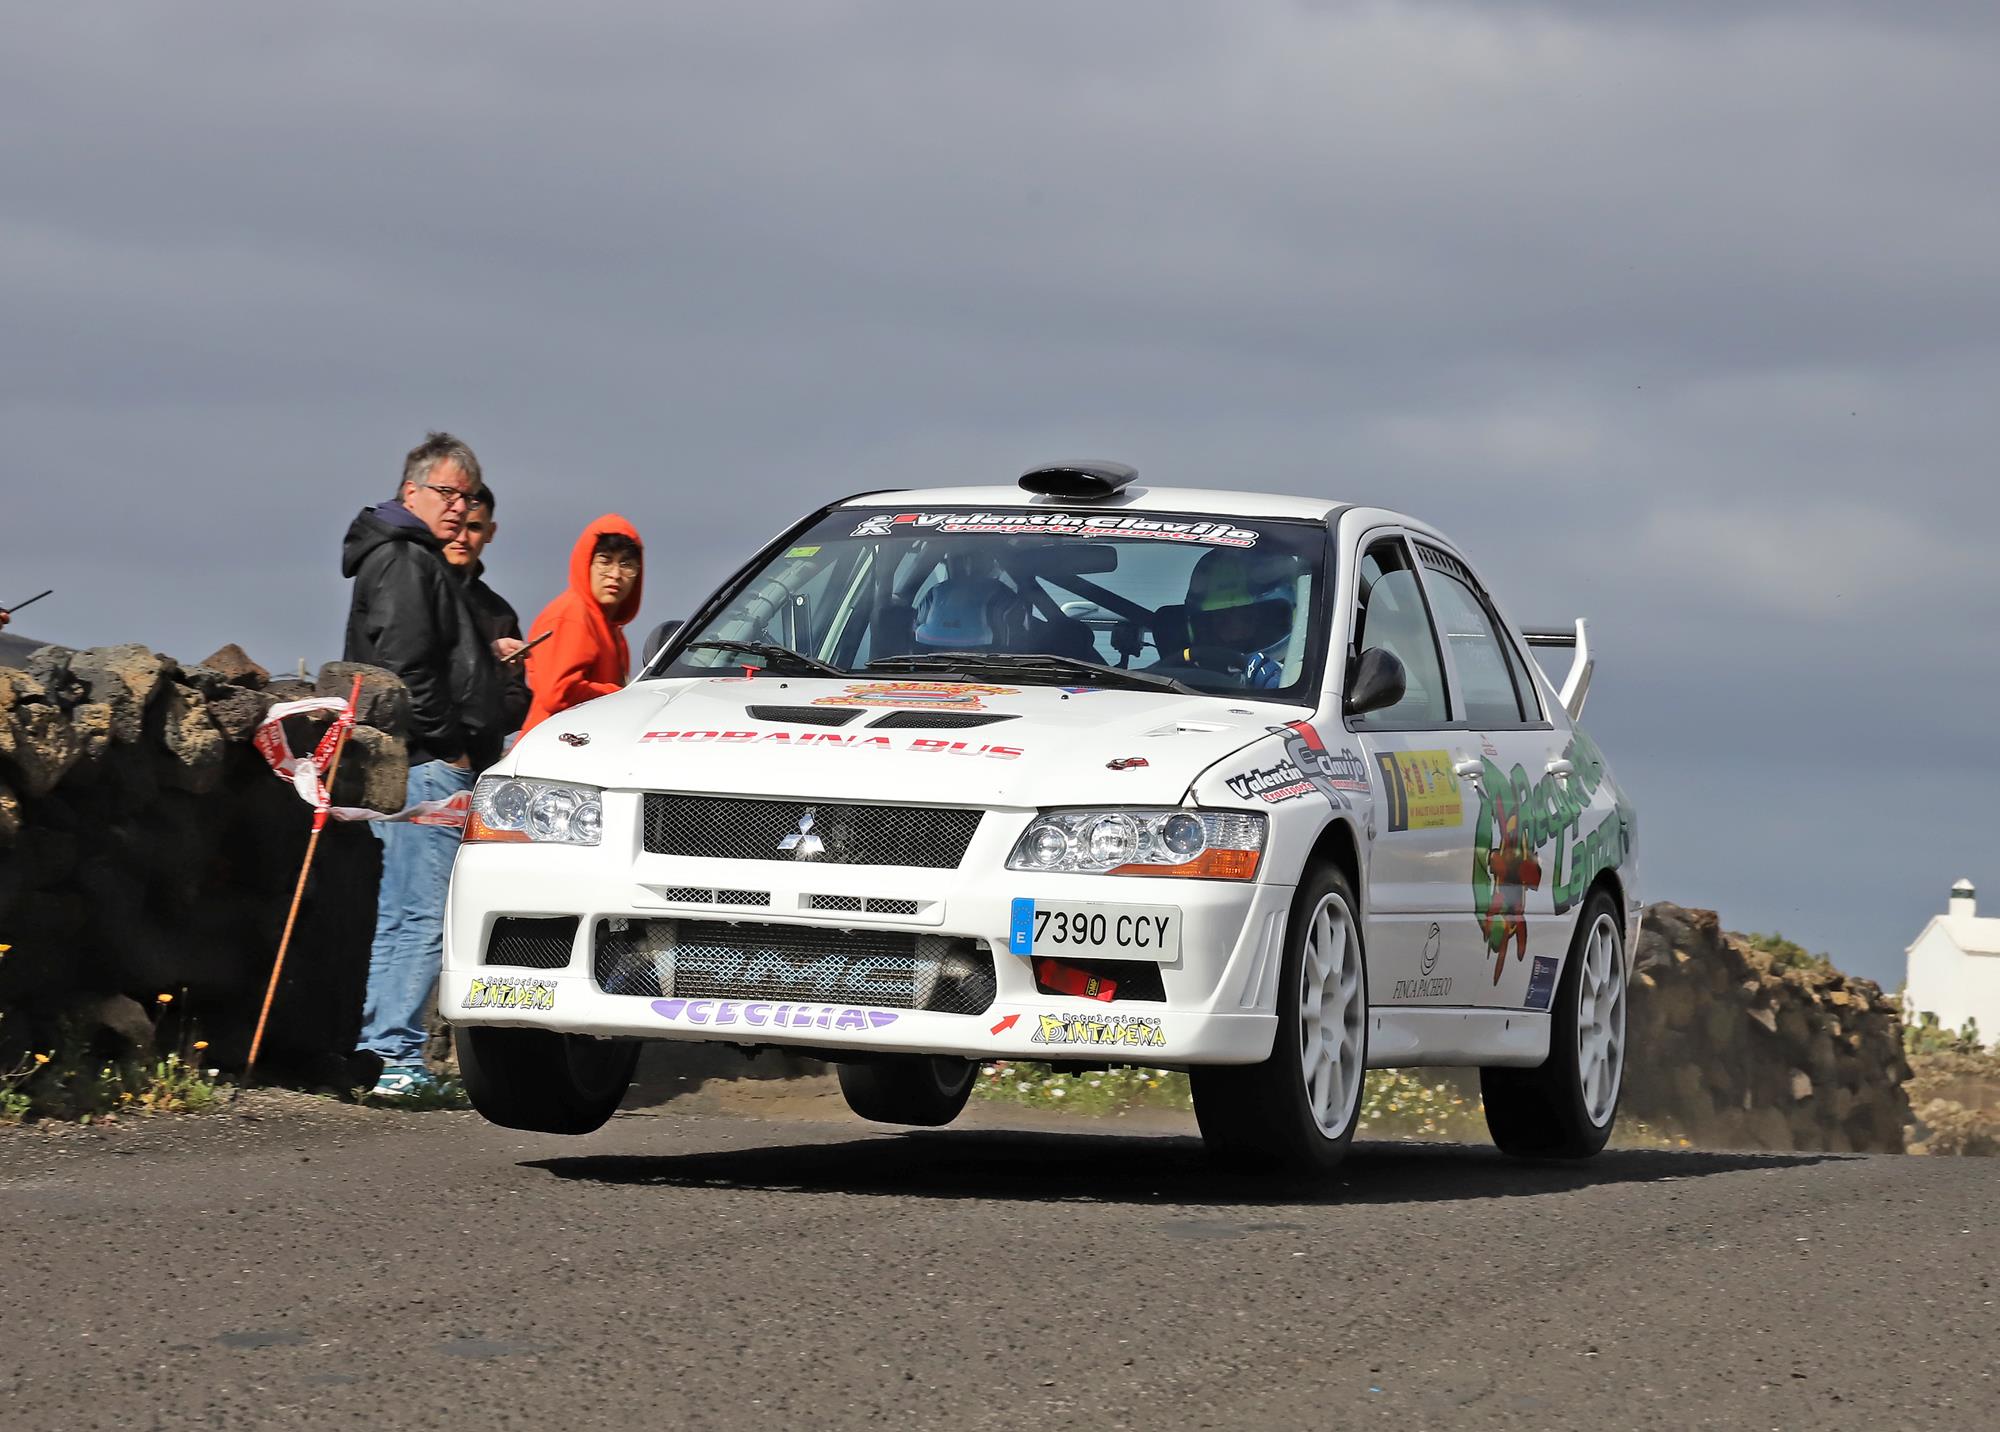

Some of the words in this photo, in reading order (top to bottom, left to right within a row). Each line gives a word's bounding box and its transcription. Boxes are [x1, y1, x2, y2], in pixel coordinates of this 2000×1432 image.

[637, 730, 893, 750] ROBAINA
[905, 737, 1025, 760] BUS
[1228, 761, 1304, 799] Valentin
[1316, 748, 1366, 782] Clavijo
[1016, 931, 1027, 944] E
[1033, 911, 1107, 946] 7390
[1116, 915, 1170, 949] CCY
[466, 978, 555, 1010] PINTADERA
[1087, 978, 1099, 997] OMP
[1392, 979, 1418, 1000] FINCA
[1416, 976, 1453, 998] PACHECO
[686, 1000, 870, 1031] CECILIA
[1038, 1014, 1167, 1047] PINTADERA
[1062, 1013, 1162, 1026] Rotulaciones
